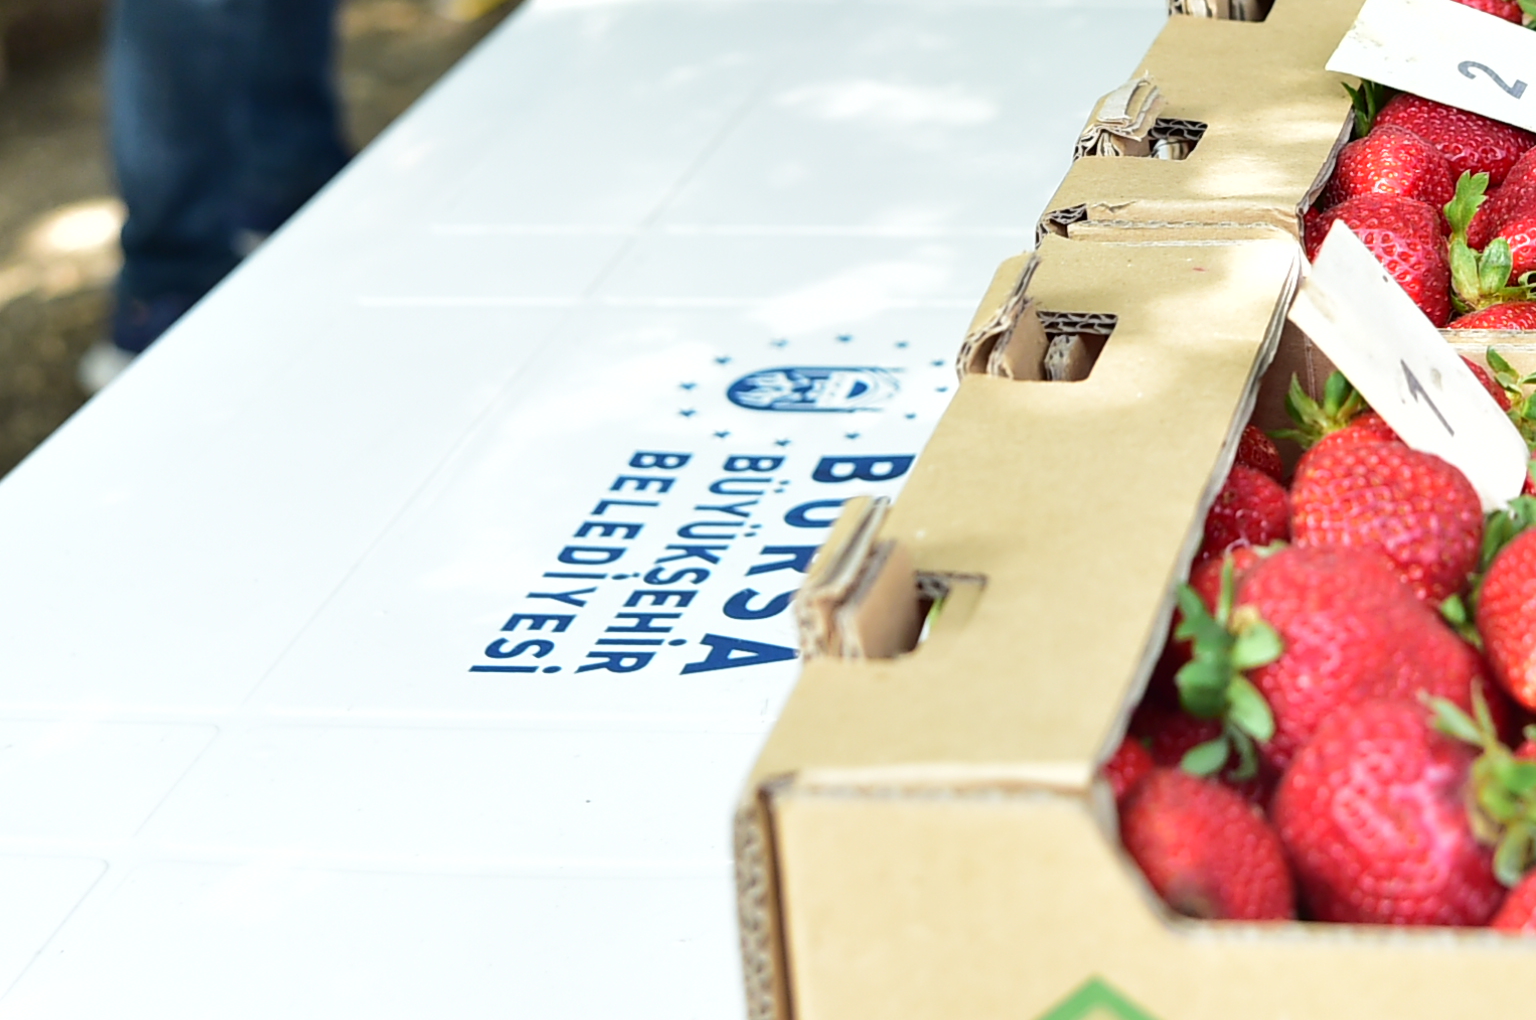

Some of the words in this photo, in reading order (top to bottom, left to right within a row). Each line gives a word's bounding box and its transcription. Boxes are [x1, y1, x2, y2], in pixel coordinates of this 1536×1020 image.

[1457, 59, 1529, 100] 2
[1400, 358, 1455, 437] 1
[468, 450, 694, 674] BELEDİYESİ
[573, 454, 792, 674] BÜYÜKŞEHİR
[679, 453, 916, 675] BURSA
